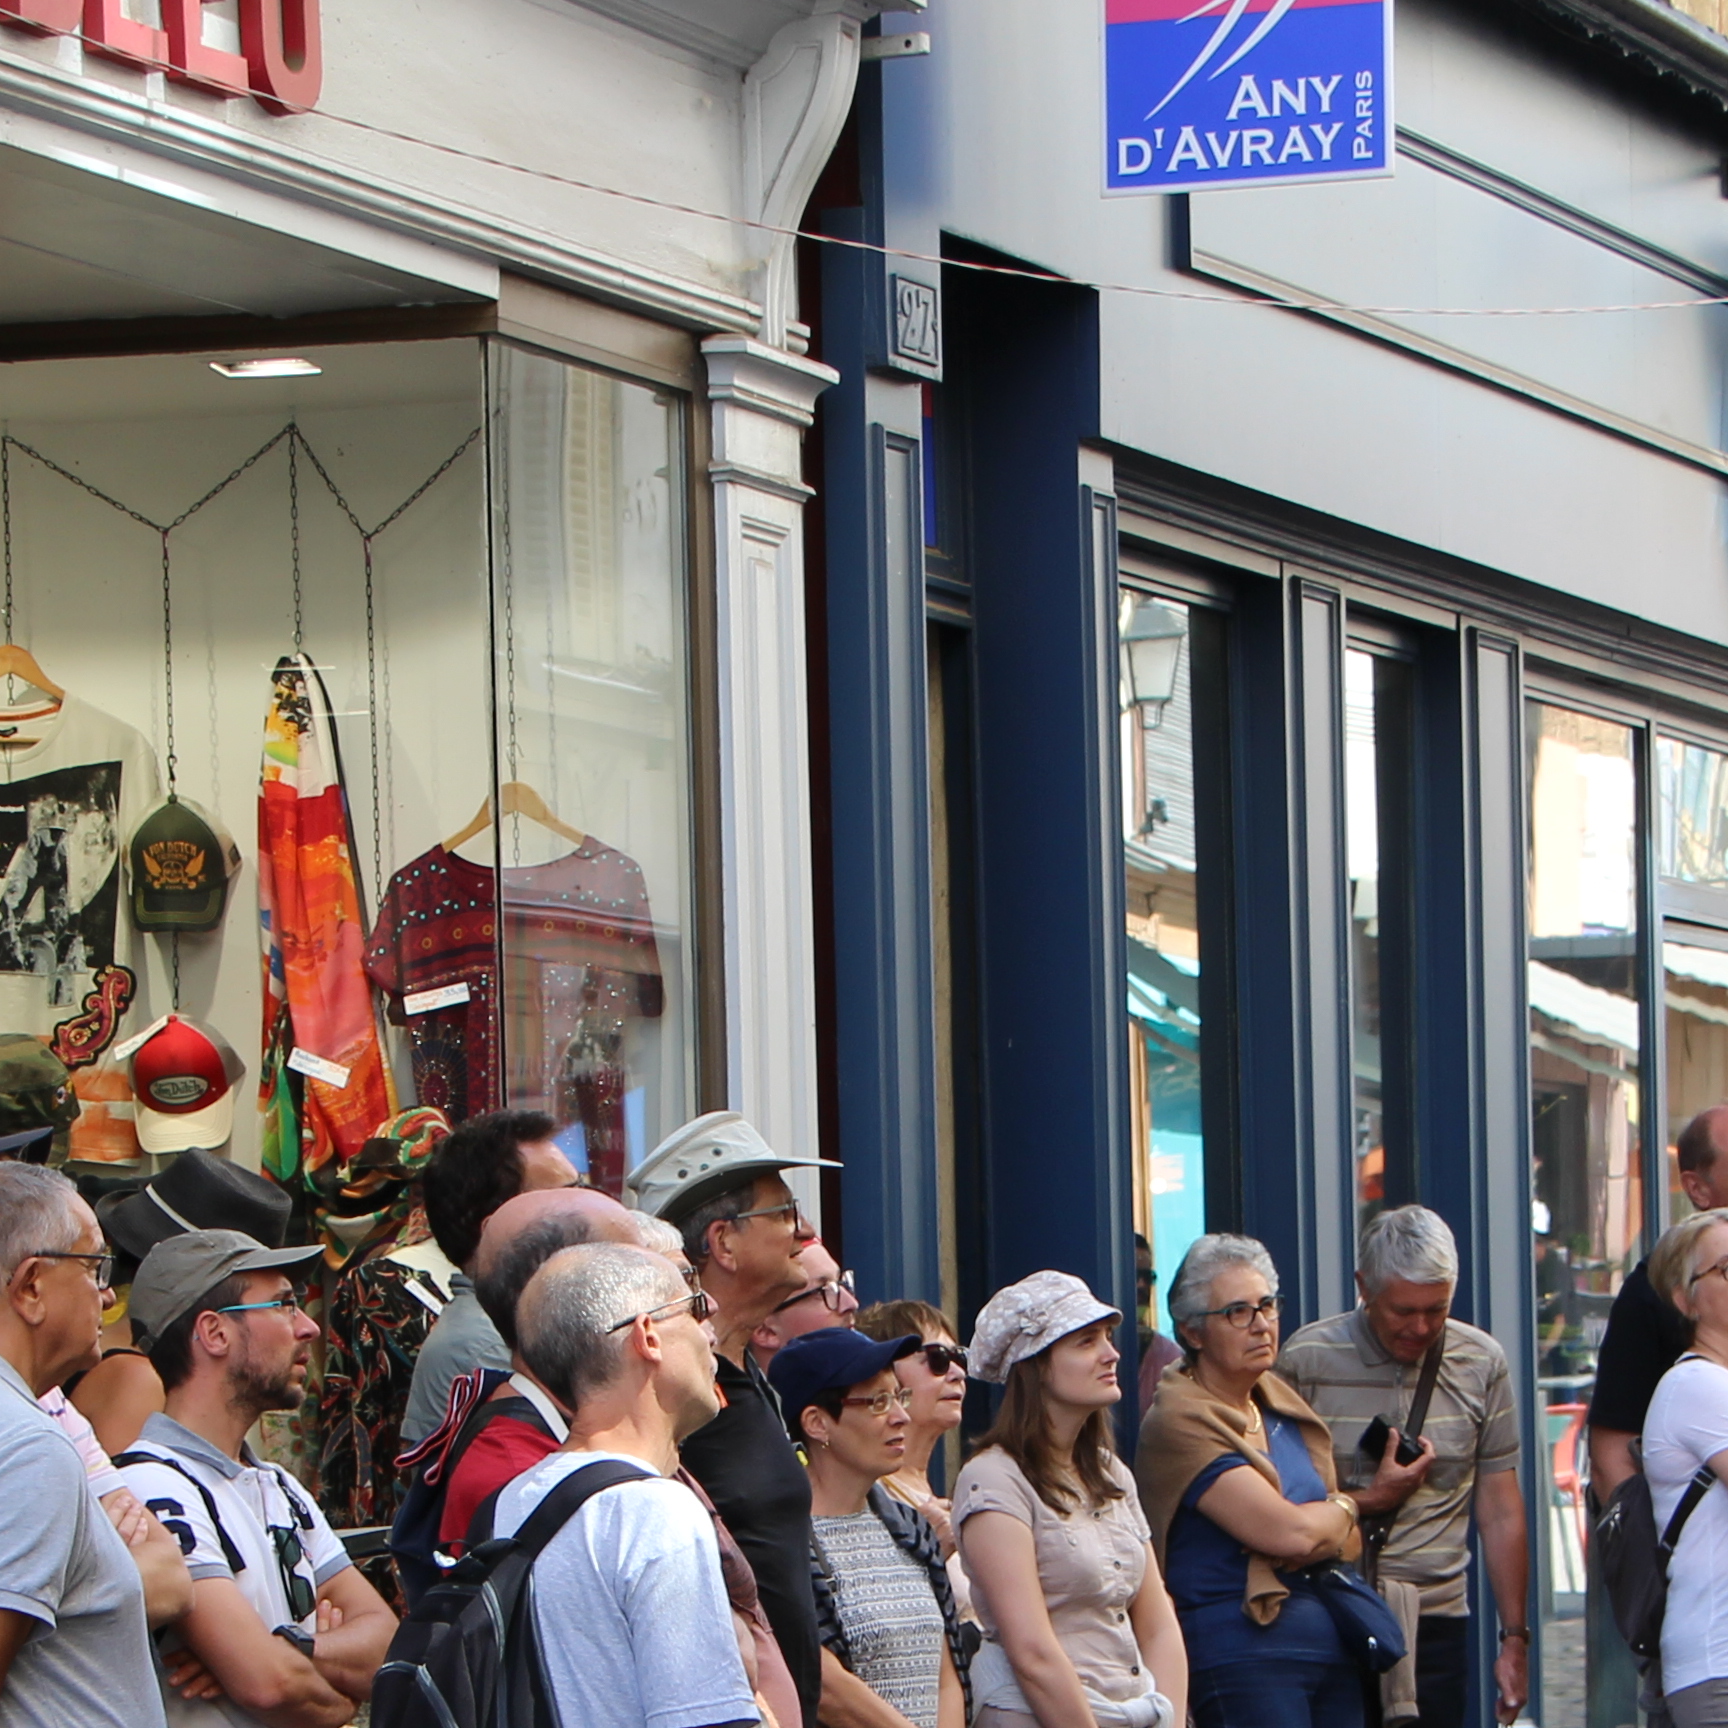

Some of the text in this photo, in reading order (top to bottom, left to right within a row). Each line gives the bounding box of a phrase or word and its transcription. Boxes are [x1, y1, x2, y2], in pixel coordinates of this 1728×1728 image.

[1226, 75, 1343, 121] ANY
[1353, 70, 1373, 160] PARIS
[1117, 123, 1344, 175] D'AVRAY
